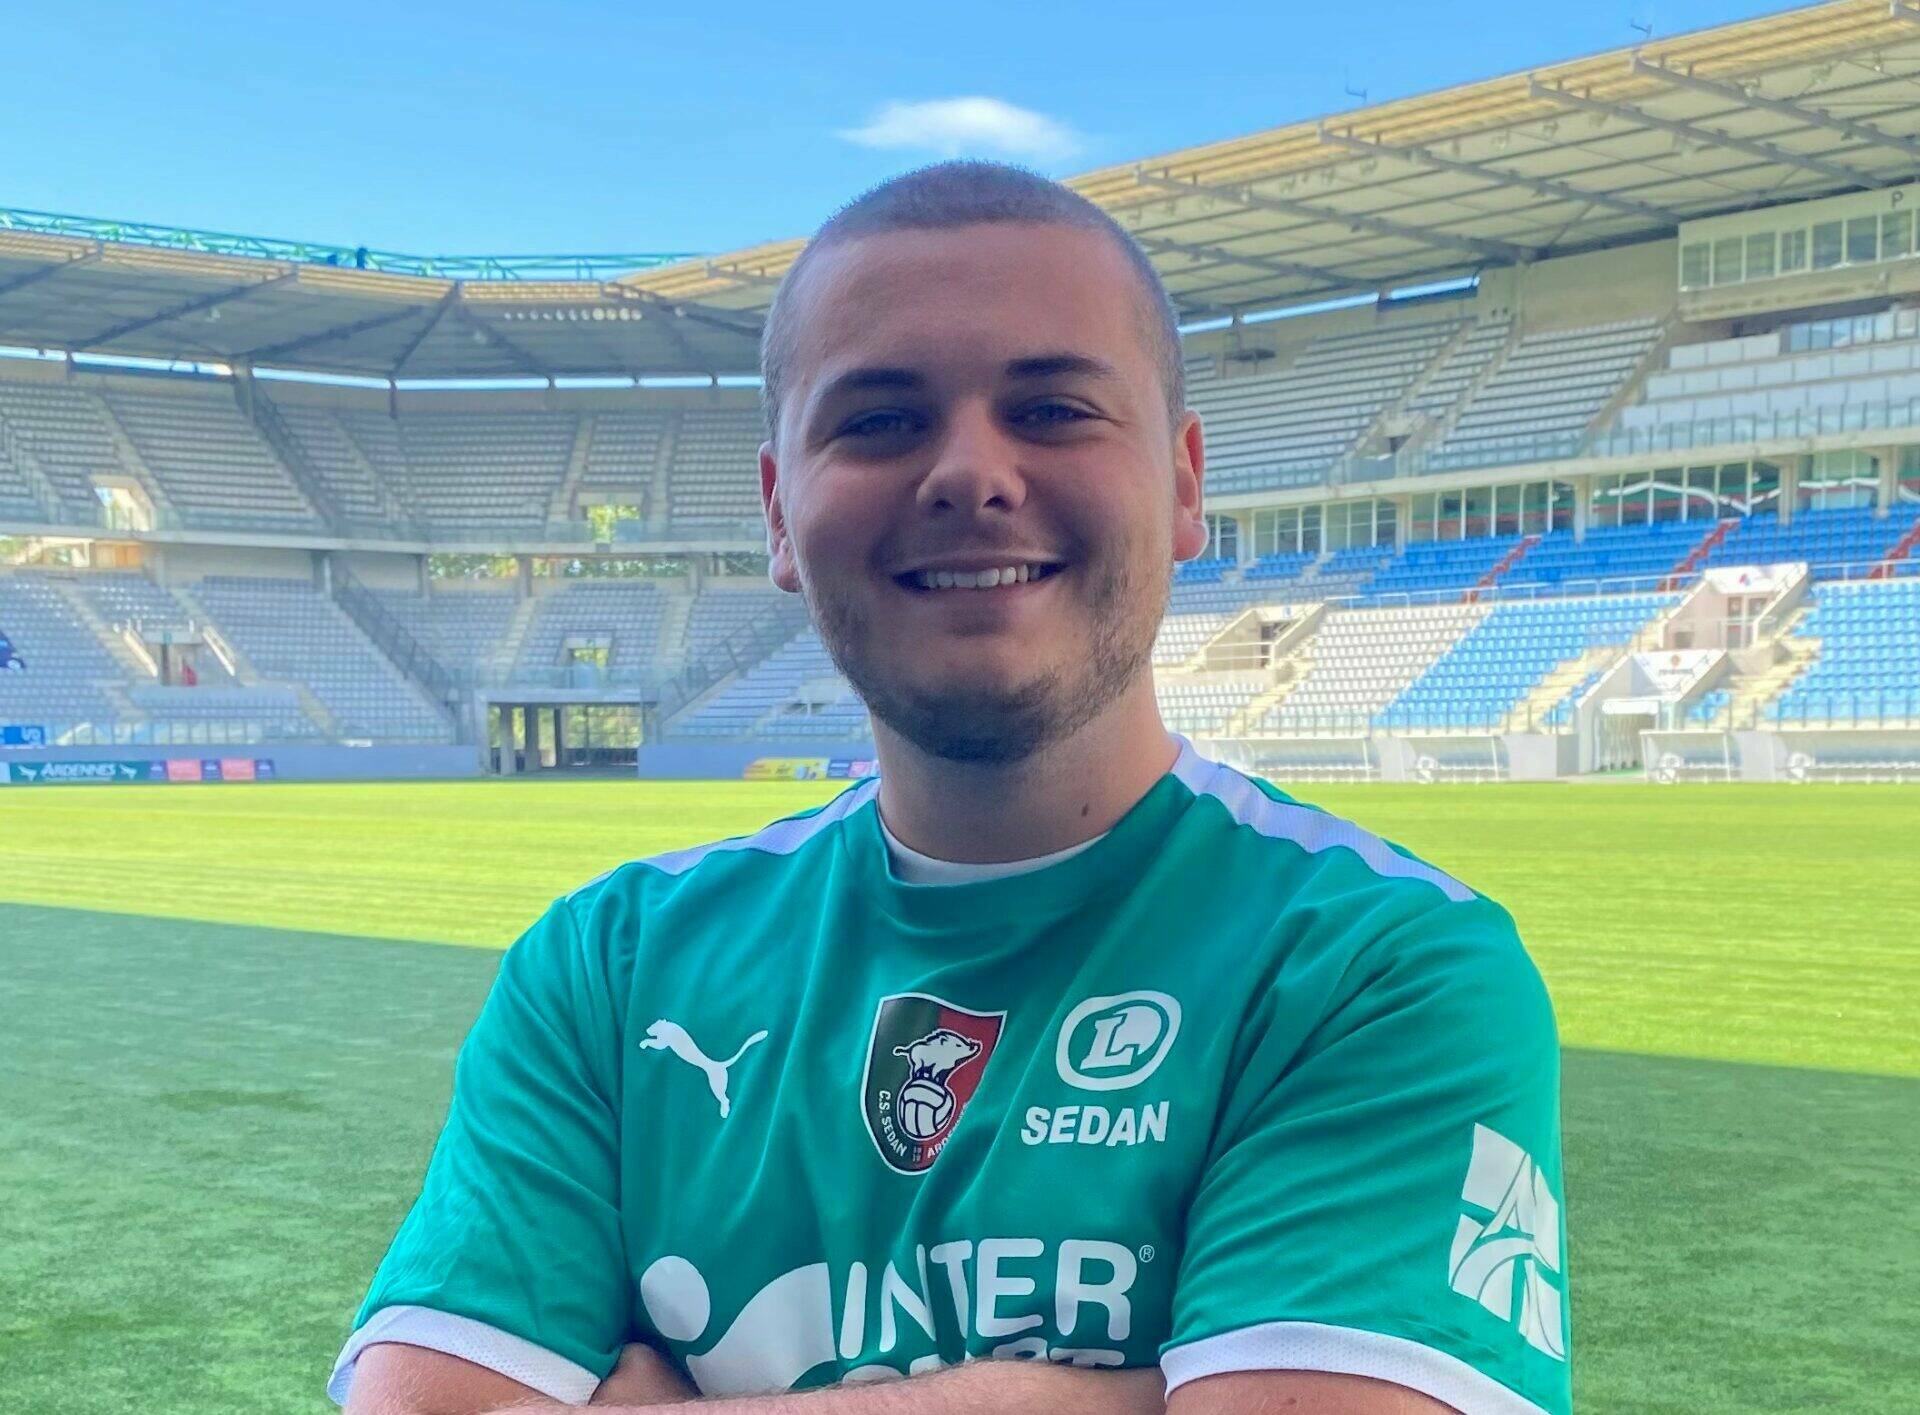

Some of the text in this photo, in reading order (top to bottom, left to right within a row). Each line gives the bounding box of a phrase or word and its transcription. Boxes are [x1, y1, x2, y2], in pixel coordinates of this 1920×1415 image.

[41, 762, 117, 778] ARDENNES
[881, 1116, 908, 1157] SEDAN
[1020, 1100, 1170, 1148] SEDAN
